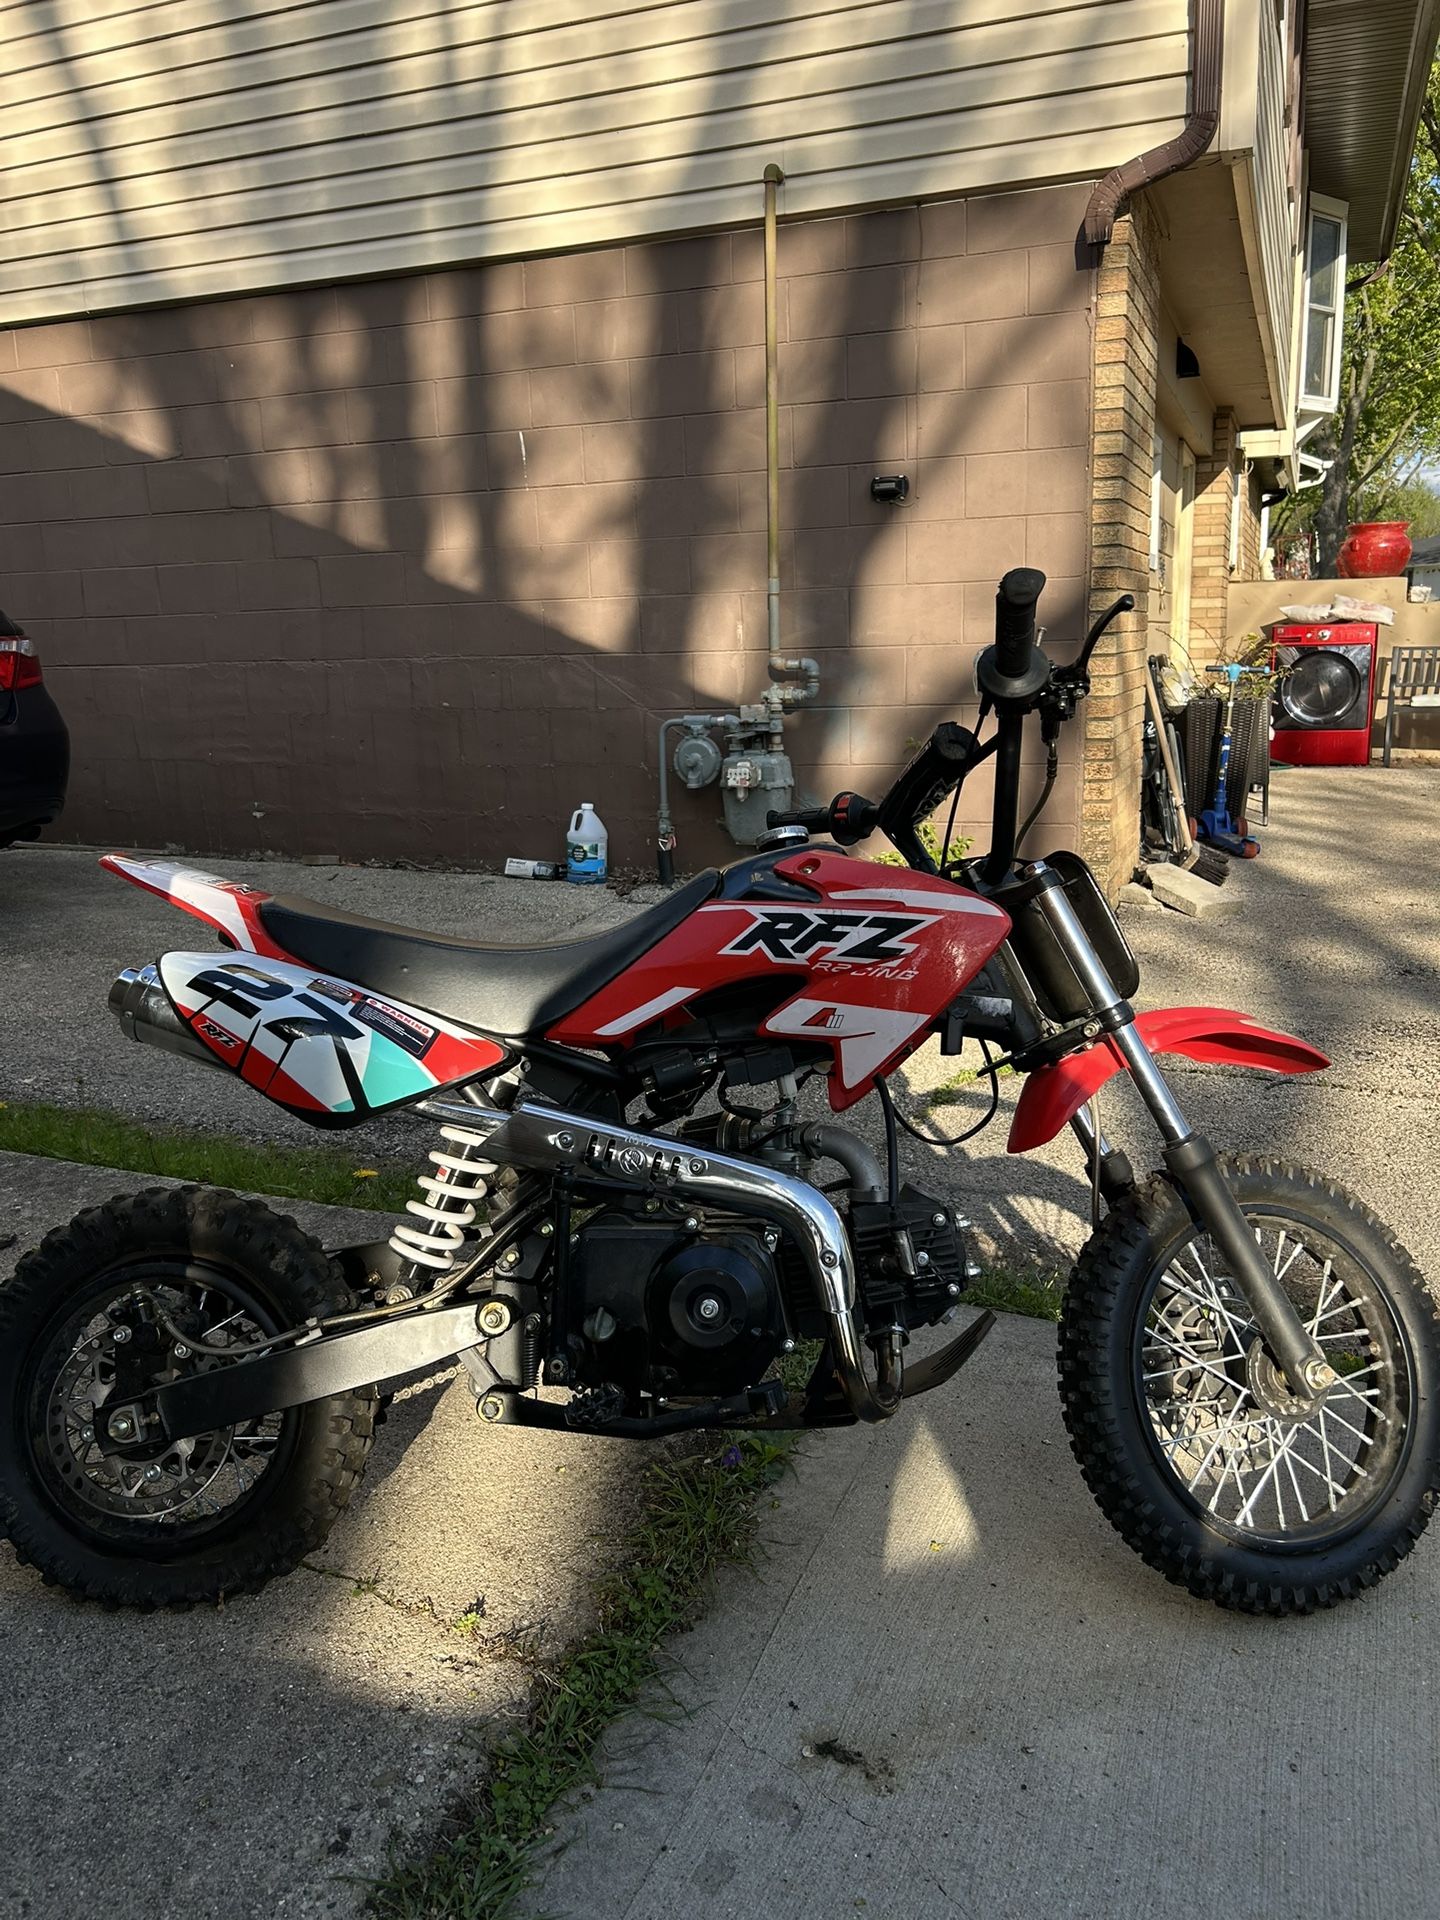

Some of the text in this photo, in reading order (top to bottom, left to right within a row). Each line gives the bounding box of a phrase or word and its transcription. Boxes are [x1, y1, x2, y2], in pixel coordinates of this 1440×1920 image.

[723, 909, 935, 963] RFZ
[198, 1019, 241, 1048] RFZ
[381, 1005, 430, 1035] WARNING
